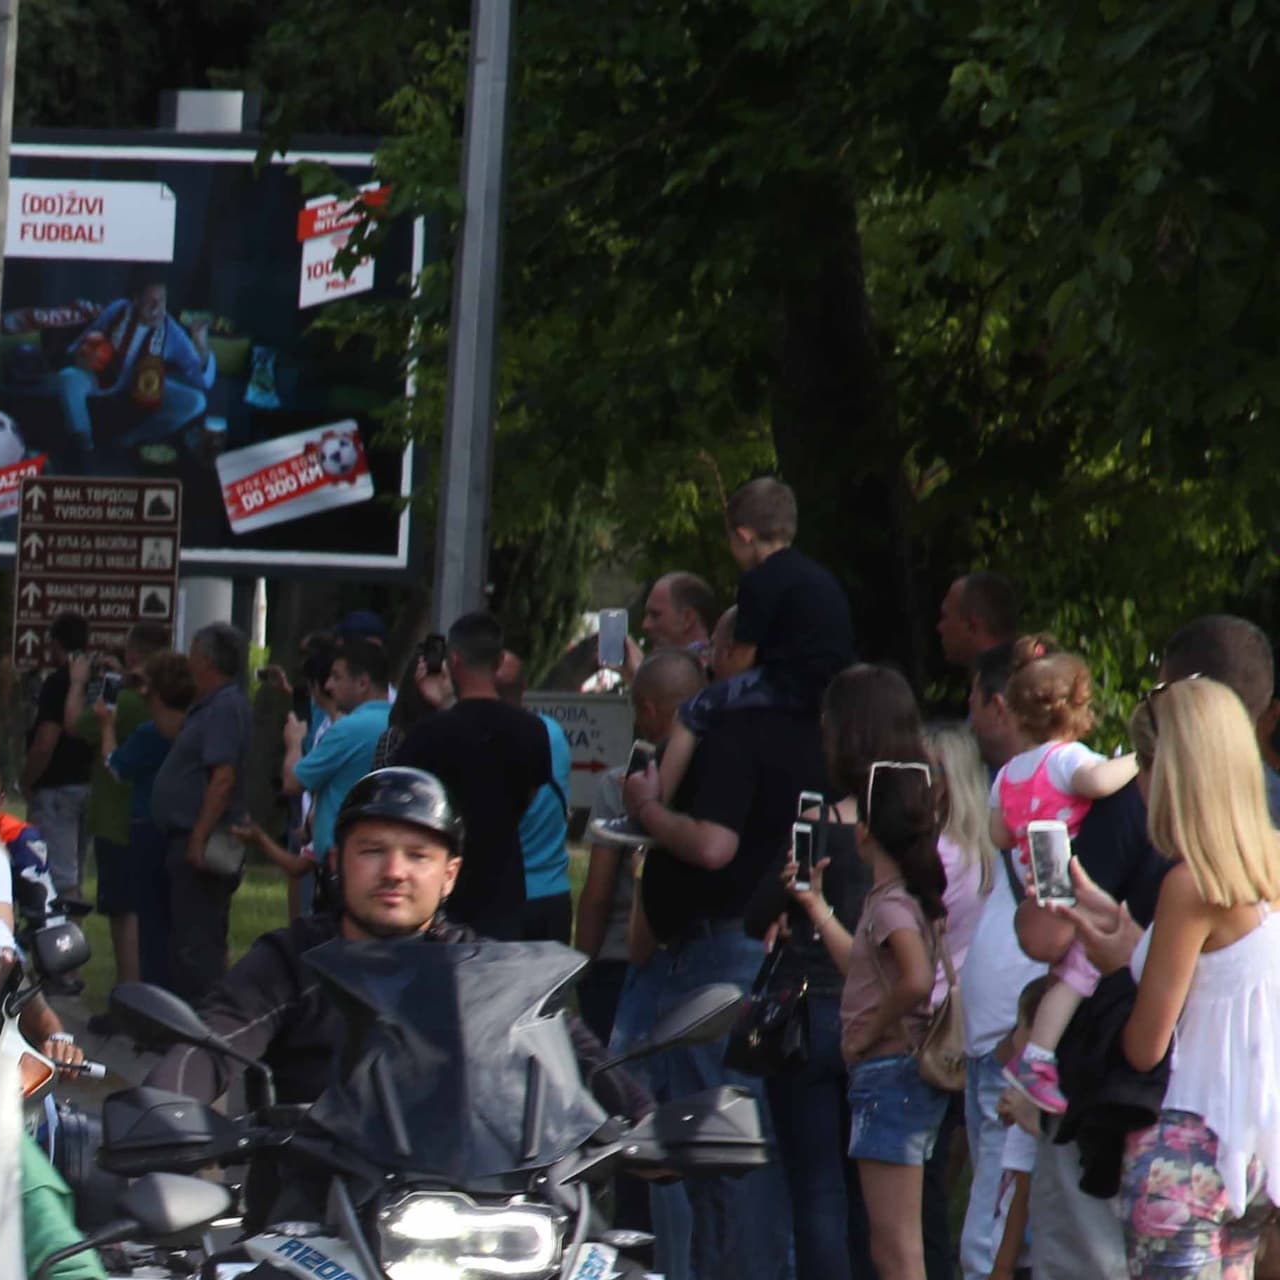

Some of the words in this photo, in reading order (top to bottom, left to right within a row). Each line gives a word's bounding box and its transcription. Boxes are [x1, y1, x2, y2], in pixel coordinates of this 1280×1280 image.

[20, 190, 104, 217] (DO)ŽIVI
[19, 223, 105, 243] FUDBAL!
[241, 490, 264, 511] DO
[265, 478, 297, 501] 300
[297, 463, 325, 487] KM
